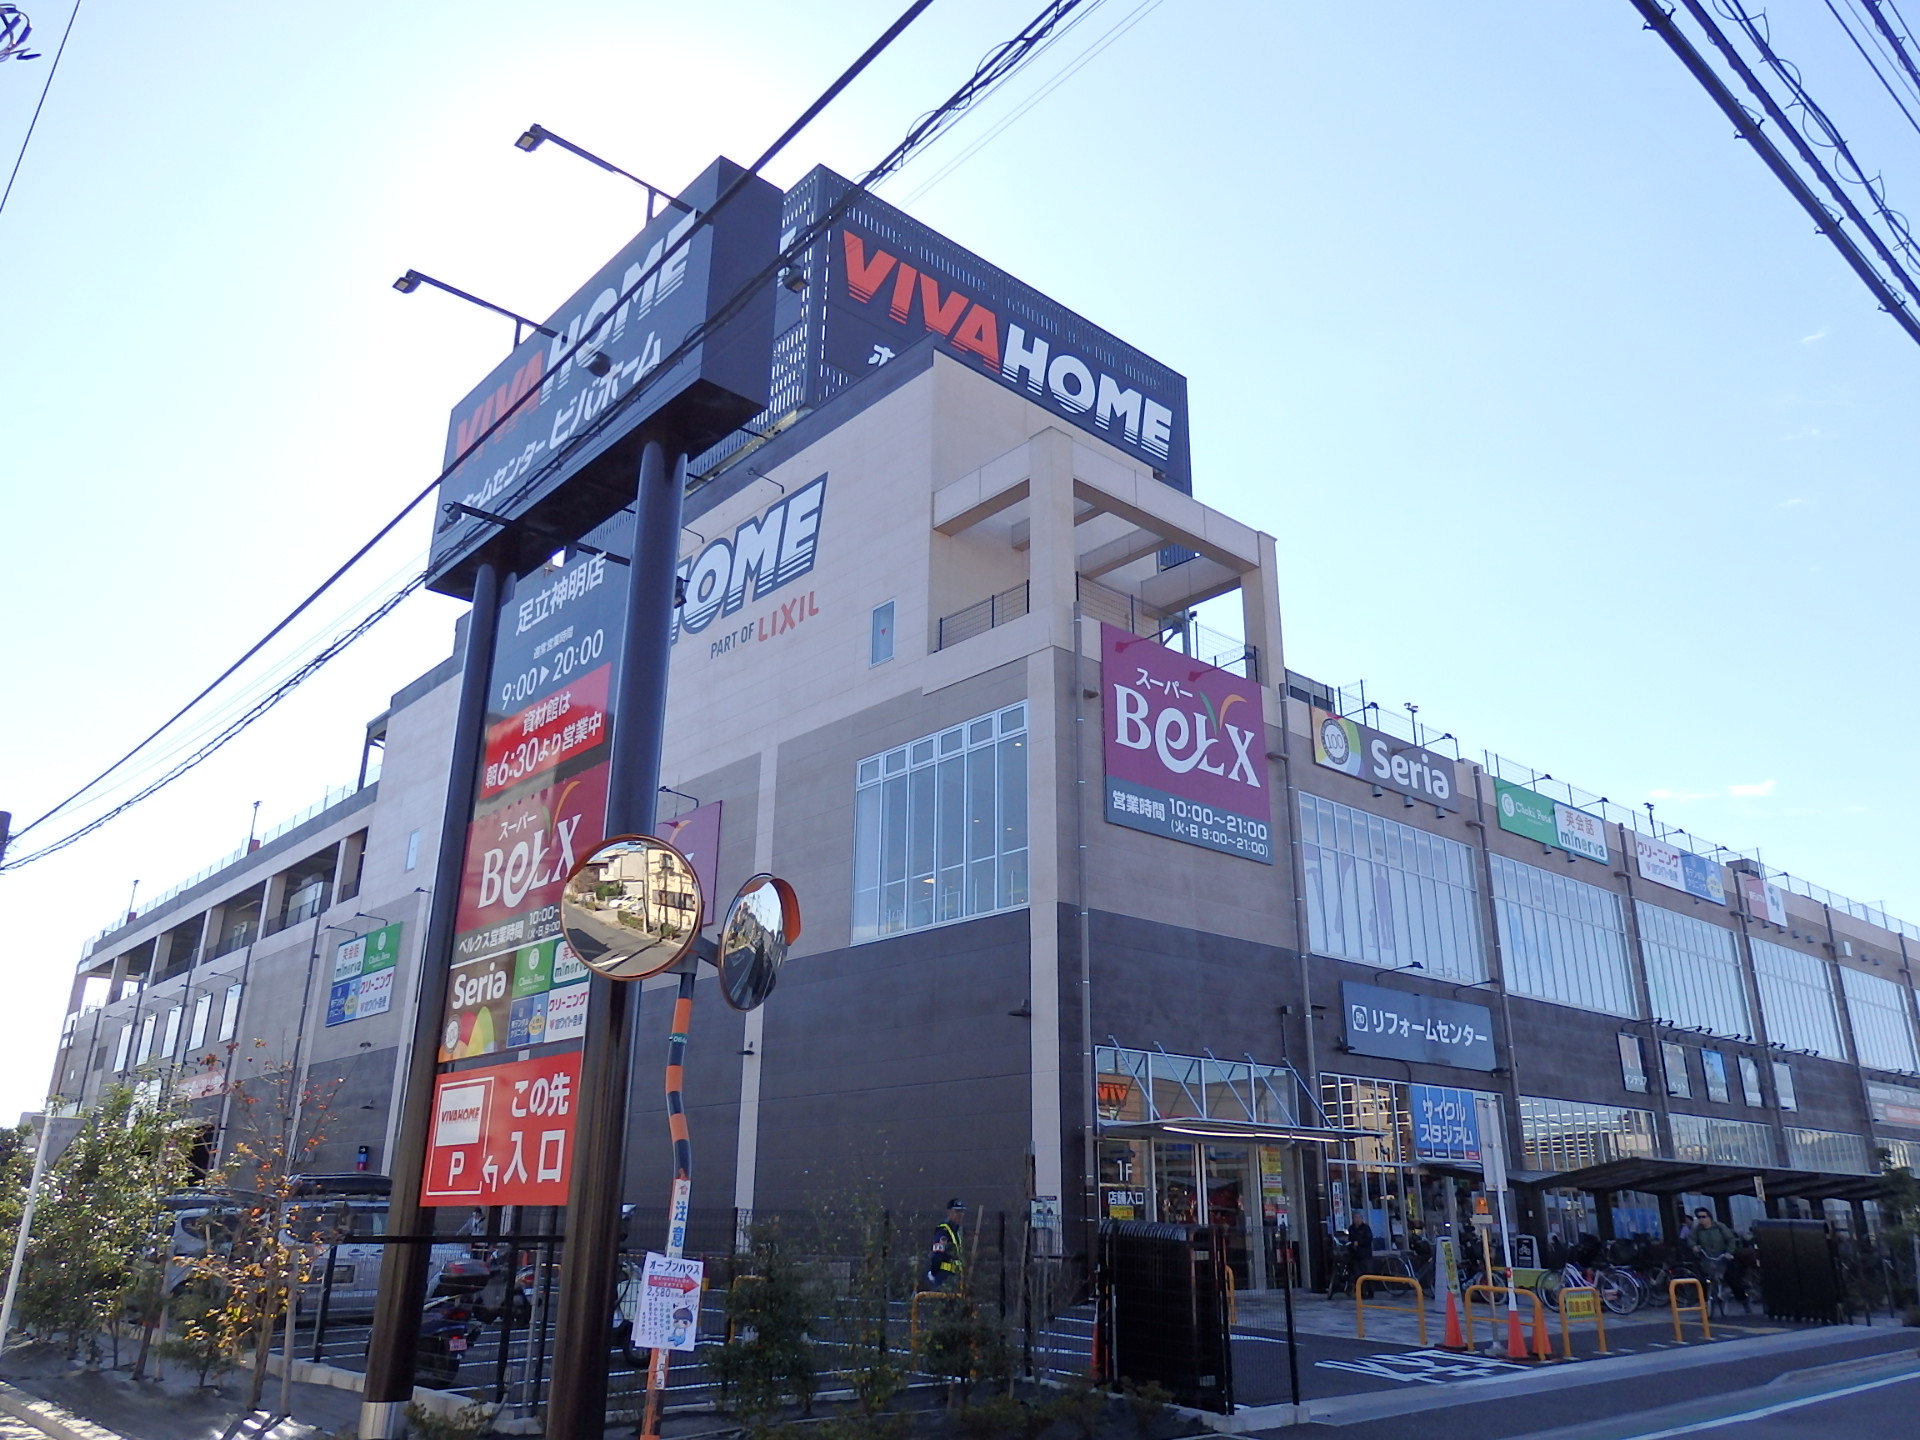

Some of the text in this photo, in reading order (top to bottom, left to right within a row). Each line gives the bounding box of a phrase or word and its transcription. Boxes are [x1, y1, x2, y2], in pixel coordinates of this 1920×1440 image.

[516, 552, 607, 636] 足立神明店
[709, 591, 819, 660] PART OF LIXIL
[1135, 667, 1193, 699] スーパー
[521, 690, 571, 737] 資材館は
[1371, 739, 1449, 800] Seria
[1112, 790, 1165, 821] 営業時間
[498, 811, 537, 841] スーパー
[1565, 810, 1594, 836] 英会話
[1637, 841, 1679, 868] クリーニング
[459, 919, 524, 954] ベルクス営業時間
[360, 973, 393, 995] クリーニング
[452, 962, 507, 1010] Seria
[549, 992, 588, 1012] クリーニング
[1372, 1009, 1488, 1047] リフォームセンター
[511, 1071, 571, 1117] この先
[1422, 1099, 1466, 1121] サイクル
[1419, 1123, 1474, 1146] スタジアム
[448, 1151, 465, 1186] P
[503, 1129, 566, 1185] 入口
[1107, 1191, 1144, 1205] 店舗入口
[671, 1201, 687, 1247] 注意
[649, 1260, 700, 1275] オープンハウス
